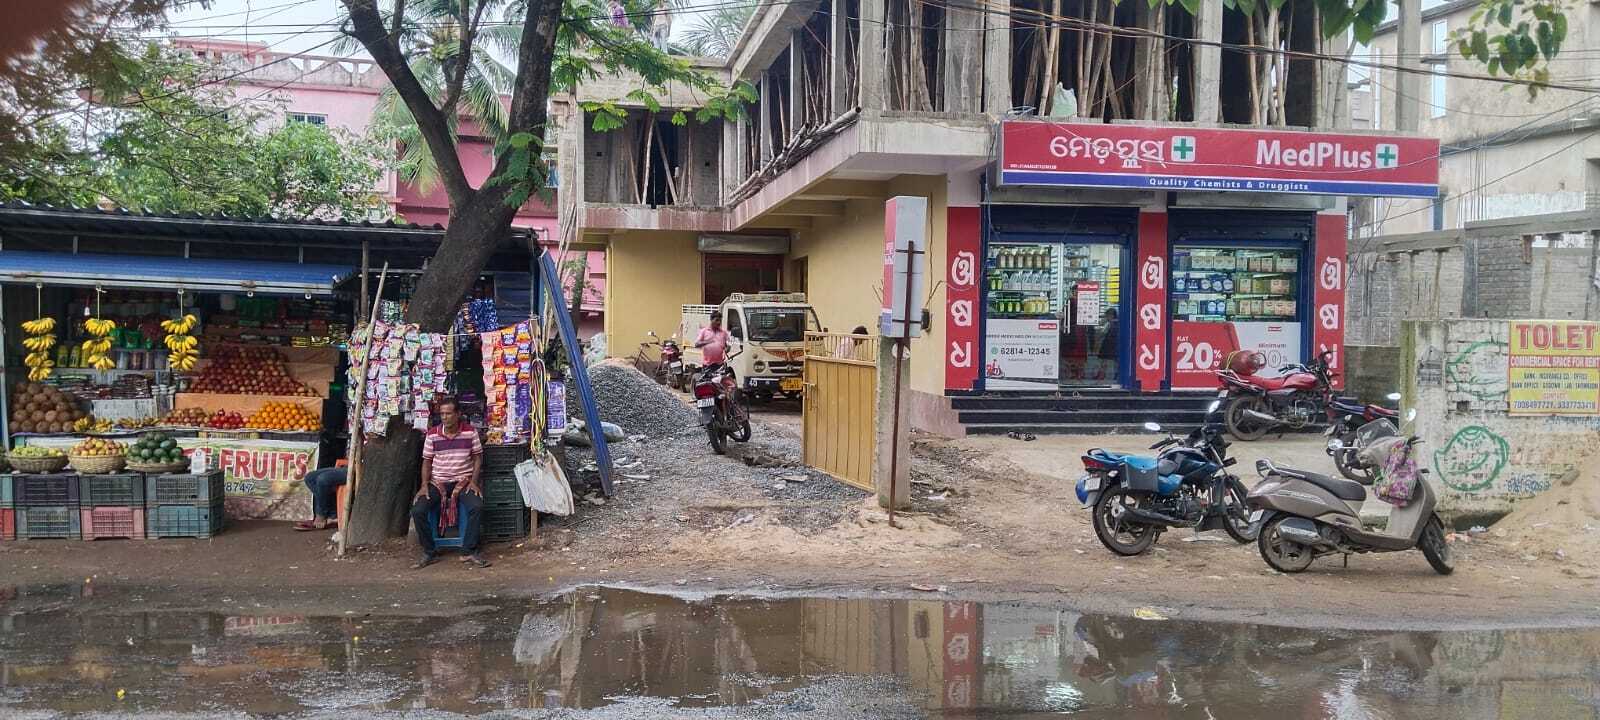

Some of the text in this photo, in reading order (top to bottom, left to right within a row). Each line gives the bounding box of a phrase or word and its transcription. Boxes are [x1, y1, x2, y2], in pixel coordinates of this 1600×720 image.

[1256, 139, 1372, 169] MedPlus
[1149, 178, 1188, 187] Quality
[1194, 179, 1241, 188] Chemists
[1259, 181, 1309, 191] Druggists
[1000, 347, 1051, 355] 62814-12345
[1510, 356, 1551, 367] COMMERCIAL
[220, 449, 308, 480] FRUITS
